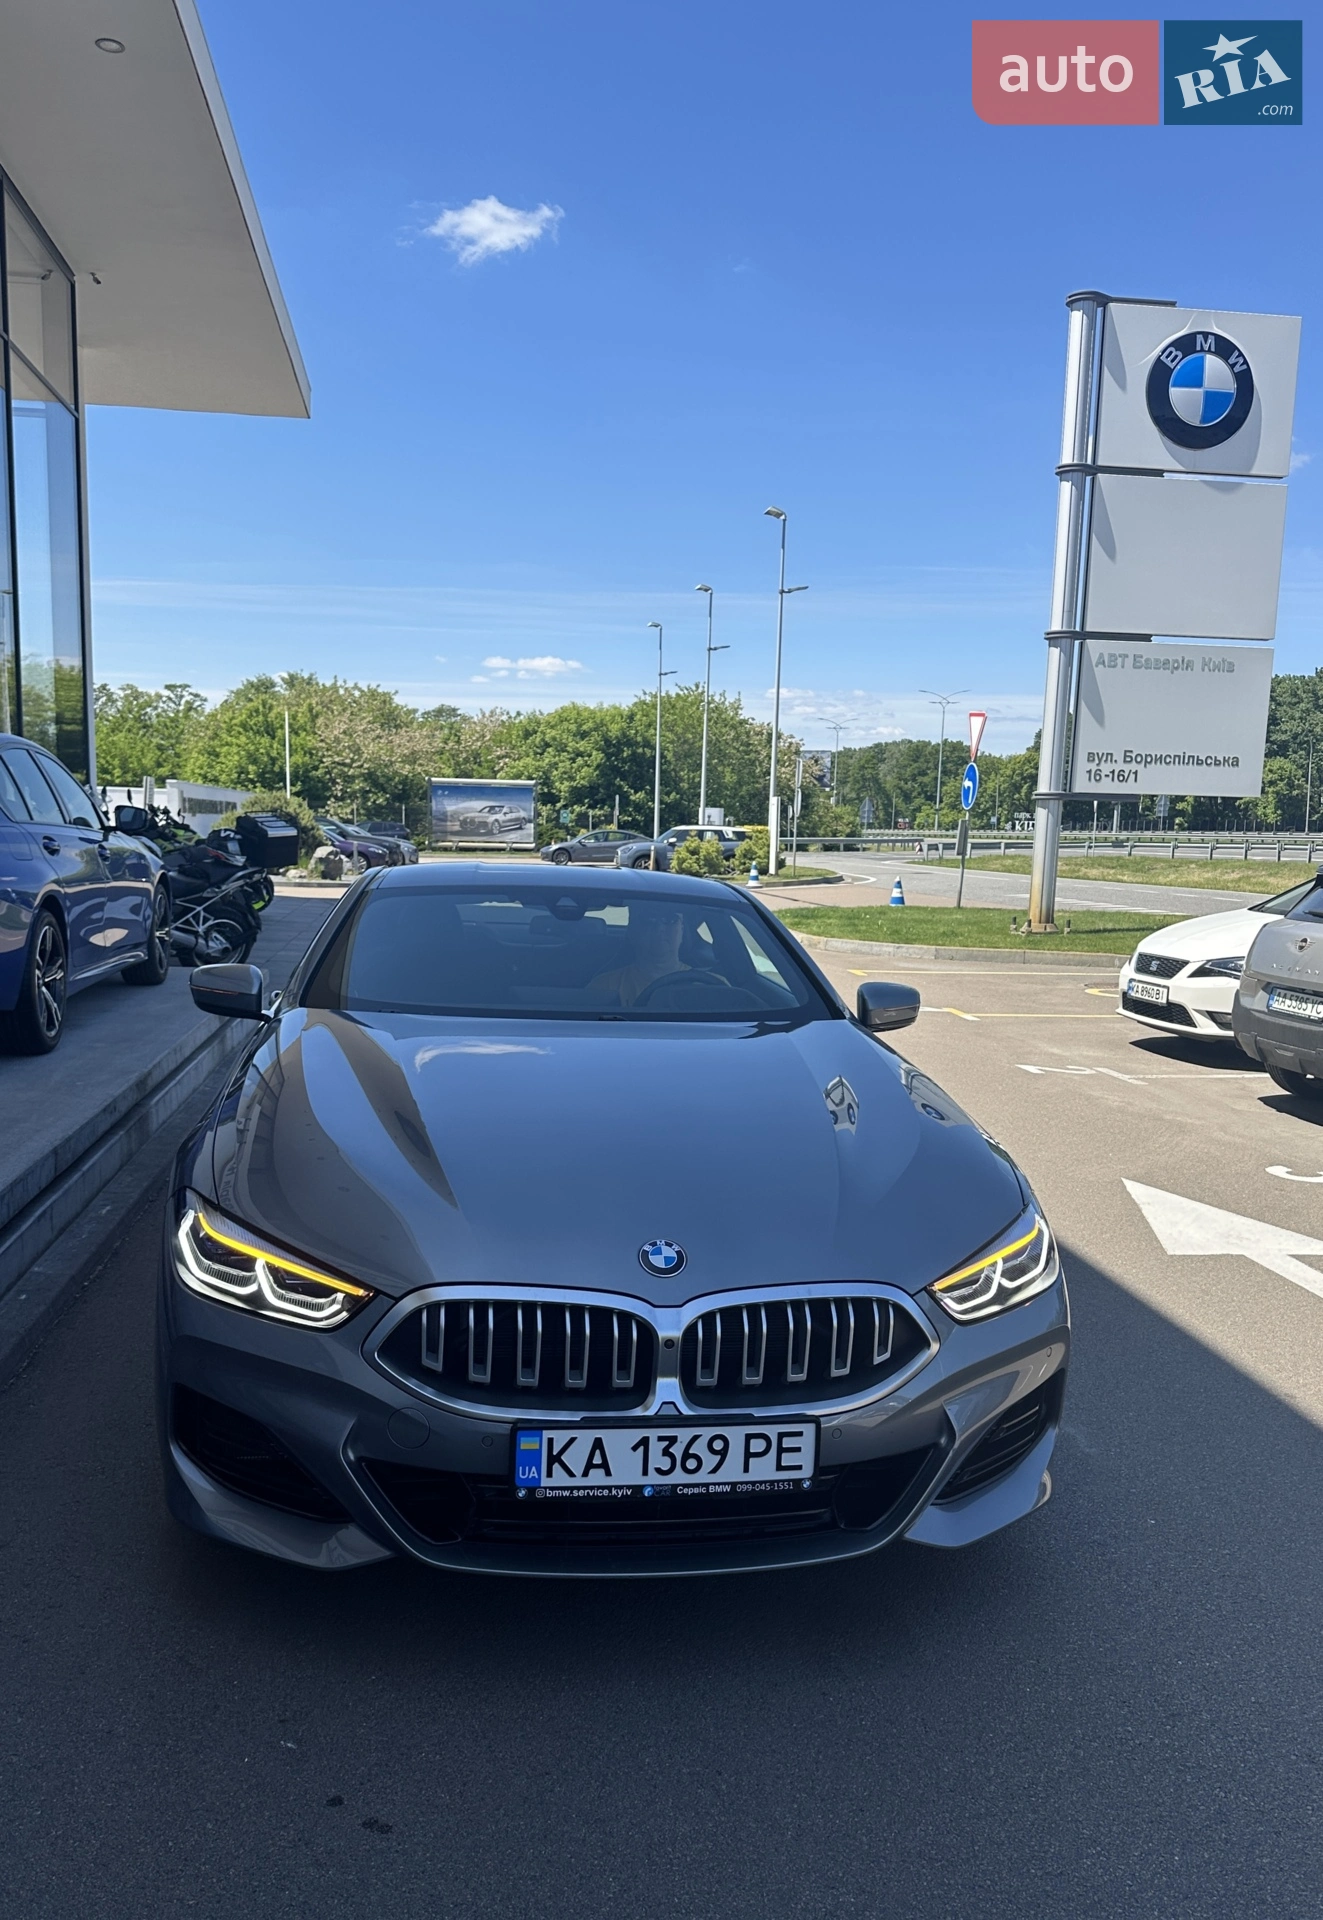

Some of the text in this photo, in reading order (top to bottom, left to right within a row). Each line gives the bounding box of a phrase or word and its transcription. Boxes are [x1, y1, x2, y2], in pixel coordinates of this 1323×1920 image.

[1160, 334, 1248, 374] BMW
[1094, 652, 1235, 674] АВТ Баварія Київ
[1086, 750, 1240, 768] вул. Бориспільська
[1086, 768, 1139, 784] 16-16/1
[1274, 991, 1288, 1007] AA
[643, 1240, 681, 1252] BMW
[545, 1431, 804, 1478] KA 1369 PE
[519, 1466, 538, 1479] UA
[546, 1487, 632, 1498] bmw.service.kyiv
[677, 1481, 794, 1495] Сервіс BMW 099-045-1551
